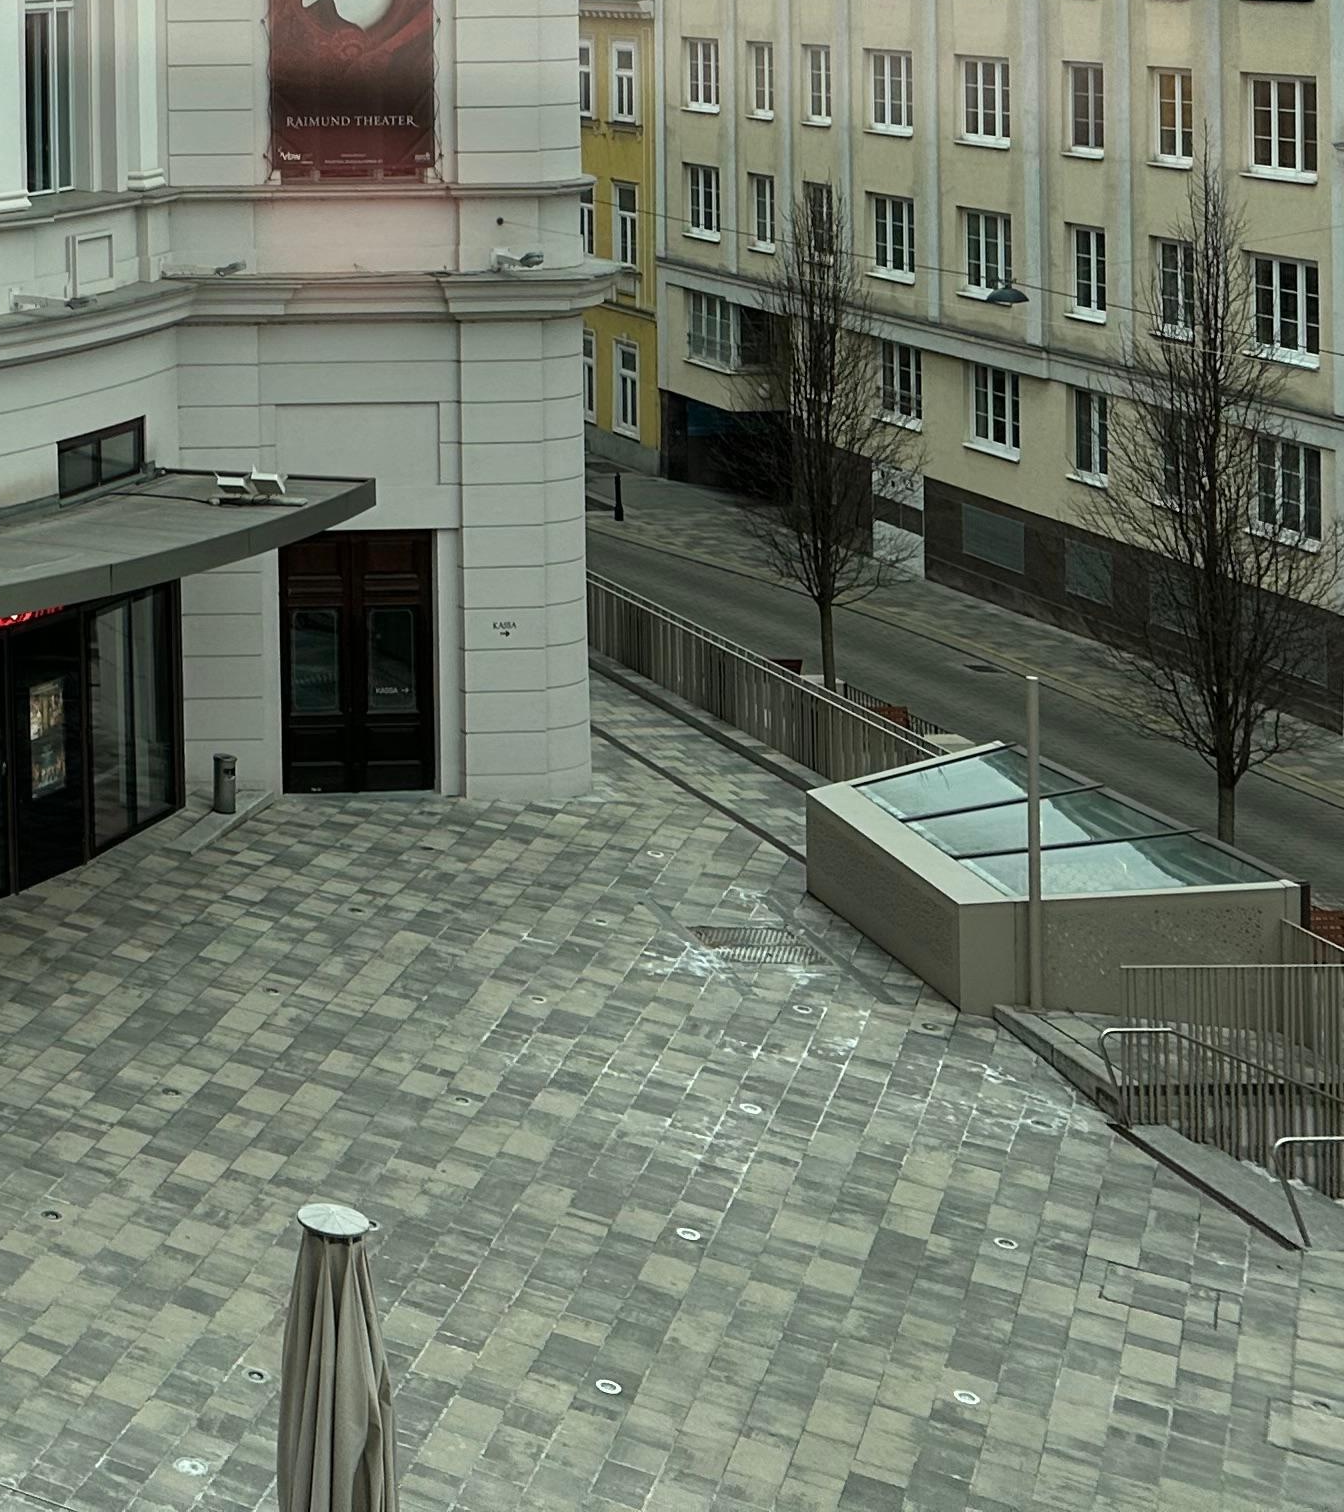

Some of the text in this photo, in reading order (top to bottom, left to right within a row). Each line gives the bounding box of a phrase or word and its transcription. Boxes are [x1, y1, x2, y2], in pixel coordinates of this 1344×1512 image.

[286, 115, 420, 129] RAIMUND THEATER
[492, 621, 517, 630] KASSA
